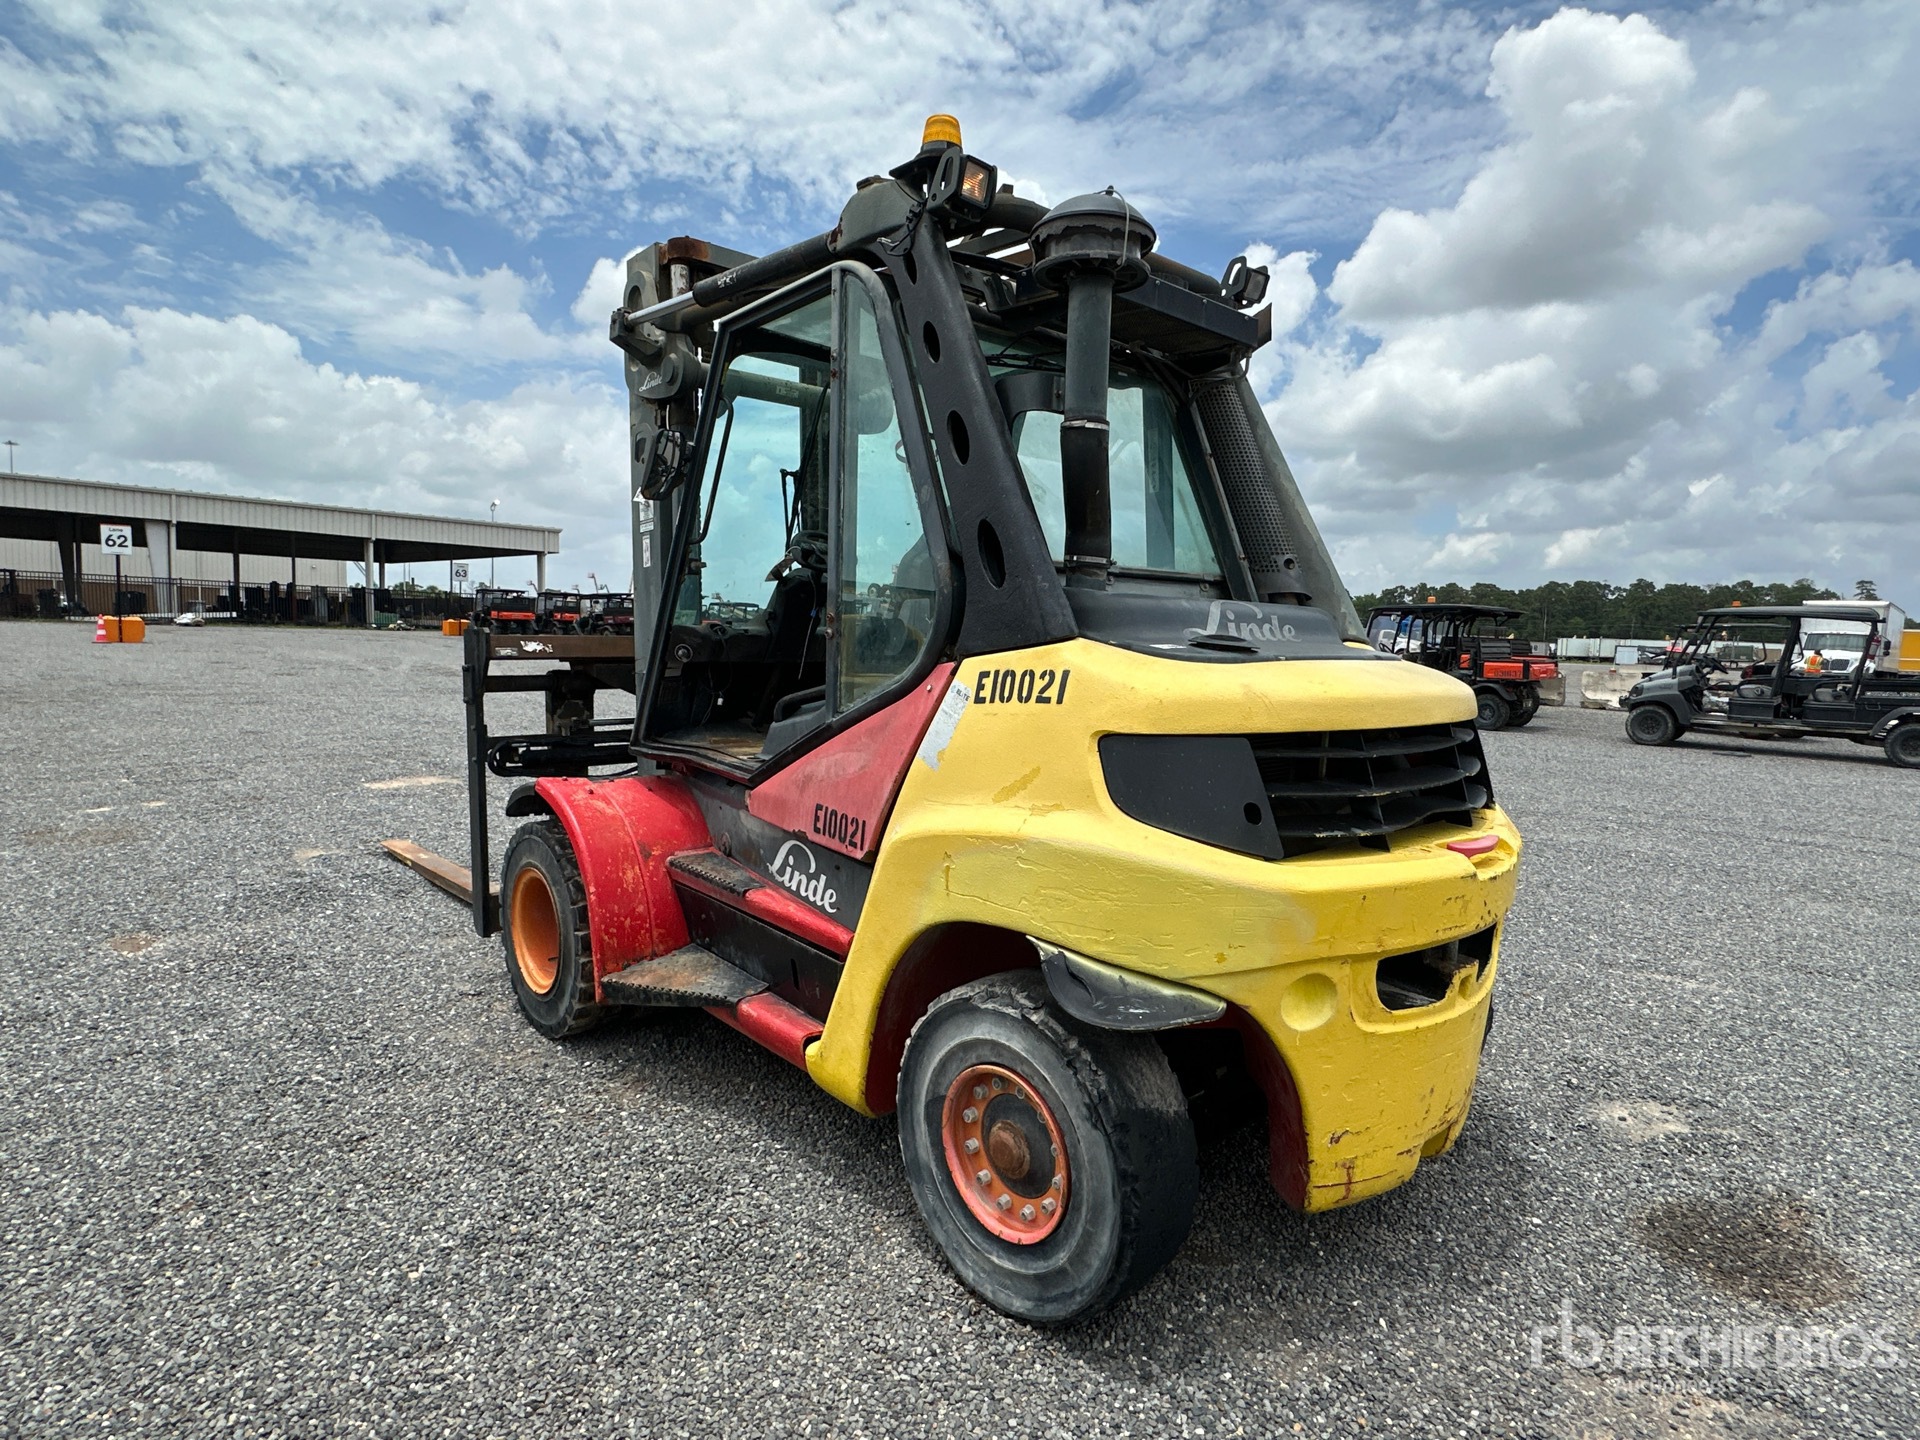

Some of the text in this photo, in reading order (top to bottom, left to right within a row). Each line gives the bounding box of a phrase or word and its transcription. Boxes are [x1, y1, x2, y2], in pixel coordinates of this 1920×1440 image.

[638, 371, 663, 392] Linde
[104, 533, 129, 548] 62
[454, 568, 468, 578] 63
[1183, 599, 1303, 643] Linde
[973, 669, 1071, 705] E10021
[813, 803, 867, 851] E10021
[766, 839, 840, 914] Linde
